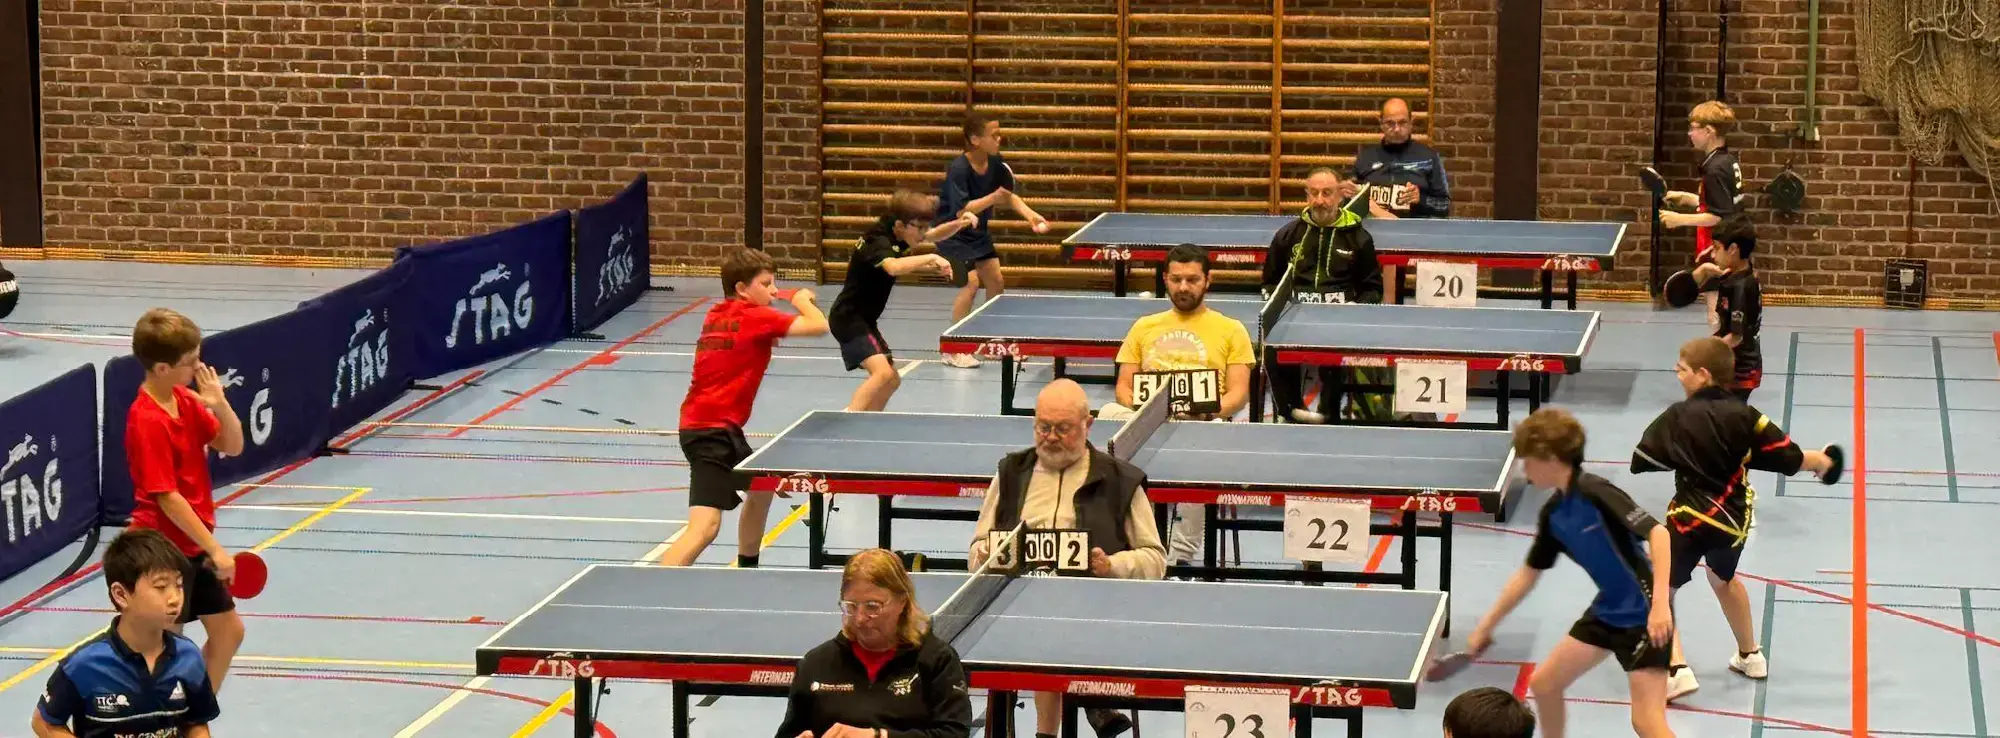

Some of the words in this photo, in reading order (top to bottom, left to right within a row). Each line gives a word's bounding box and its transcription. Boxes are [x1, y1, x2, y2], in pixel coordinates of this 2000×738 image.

[1091, 248, 1132, 260] STAG
[1432, 274, 1464, 299] 20
[445, 280, 534, 348] STAG
[974, 342, 1020, 356] STAG
[331, 328, 389, 408] STAG
[1496, 358, 1545, 371] STAG
[1139, 381, 1150, 402] 5
[1199, 377, 1210, 400] 1
[1415, 376, 1449, 403] 21
[774, 477, 830, 493] STAG
[0, 457, 62, 542] TAG
[1400, 495, 1457, 511] STAG
[1306, 517, 1350, 551] 22
[997, 539, 1012, 566] 3
[1067, 540, 1081, 567] 2
[529, 659, 595, 678] STAG
[749, 669, 796, 684] INTERNATI
[1067, 680, 1136, 697] INTERNATIONAL
[1291, 685, 1363, 706] STAG
[1213, 712, 1266, 738] 23
